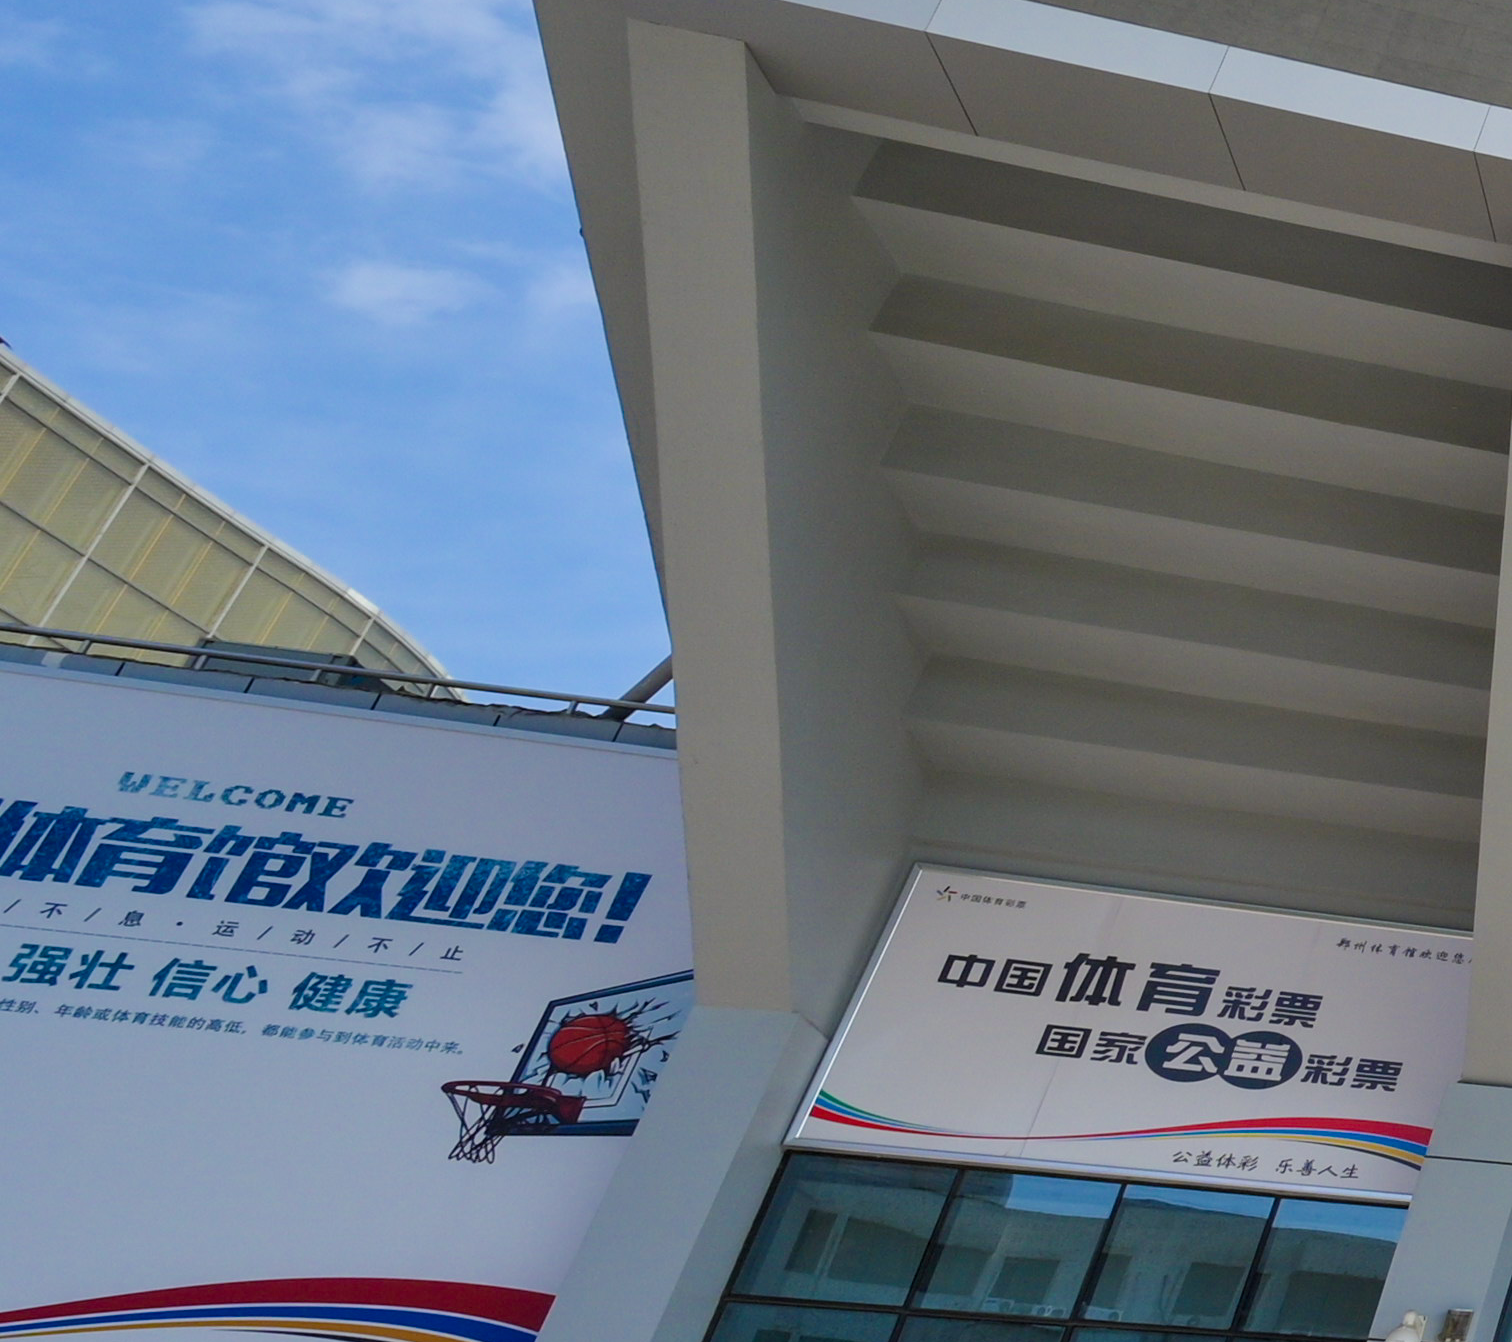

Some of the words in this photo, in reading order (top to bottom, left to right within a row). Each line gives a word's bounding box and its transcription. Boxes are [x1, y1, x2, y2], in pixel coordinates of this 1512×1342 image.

[117, 770, 354, 819] WELCOME
[960, 892, 1027, 910] 中国体育彩票
[1, 943, 136, 992] 强壮
[148, 957, 269, 1005] 信心
[288, 971, 414, 1019] 健康
[937, 953, 1325, 1030] 中国体育彩票
[1036, 1023, 1405, 1094] 国家公益彩票
[1172, 1150, 1260, 1172] 公益体彩
[1275, 1158, 1360, 1180] 乐善人生
